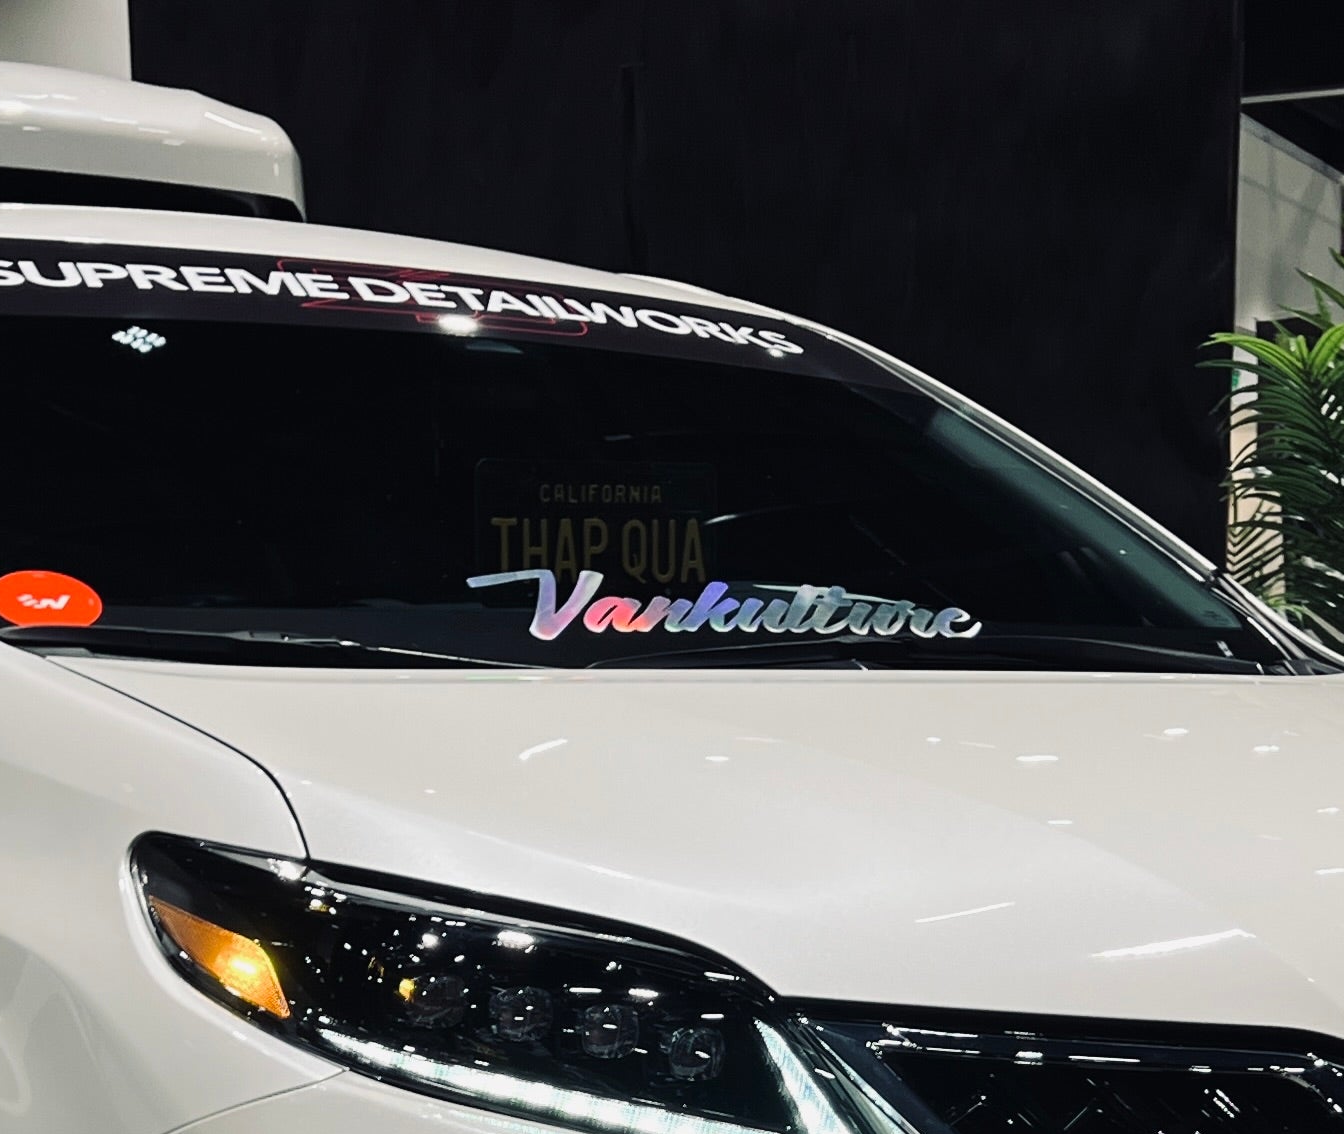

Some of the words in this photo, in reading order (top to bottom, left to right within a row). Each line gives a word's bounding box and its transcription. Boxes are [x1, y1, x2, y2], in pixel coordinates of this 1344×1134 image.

[348, 275, 805, 356] DETAILWORKS
[539, 483, 663, 505] CALIFORNIA
[490, 516, 609, 584] THAP
[621, 517, 707, 585] QUA
[466, 569, 983, 641] Vankulture
